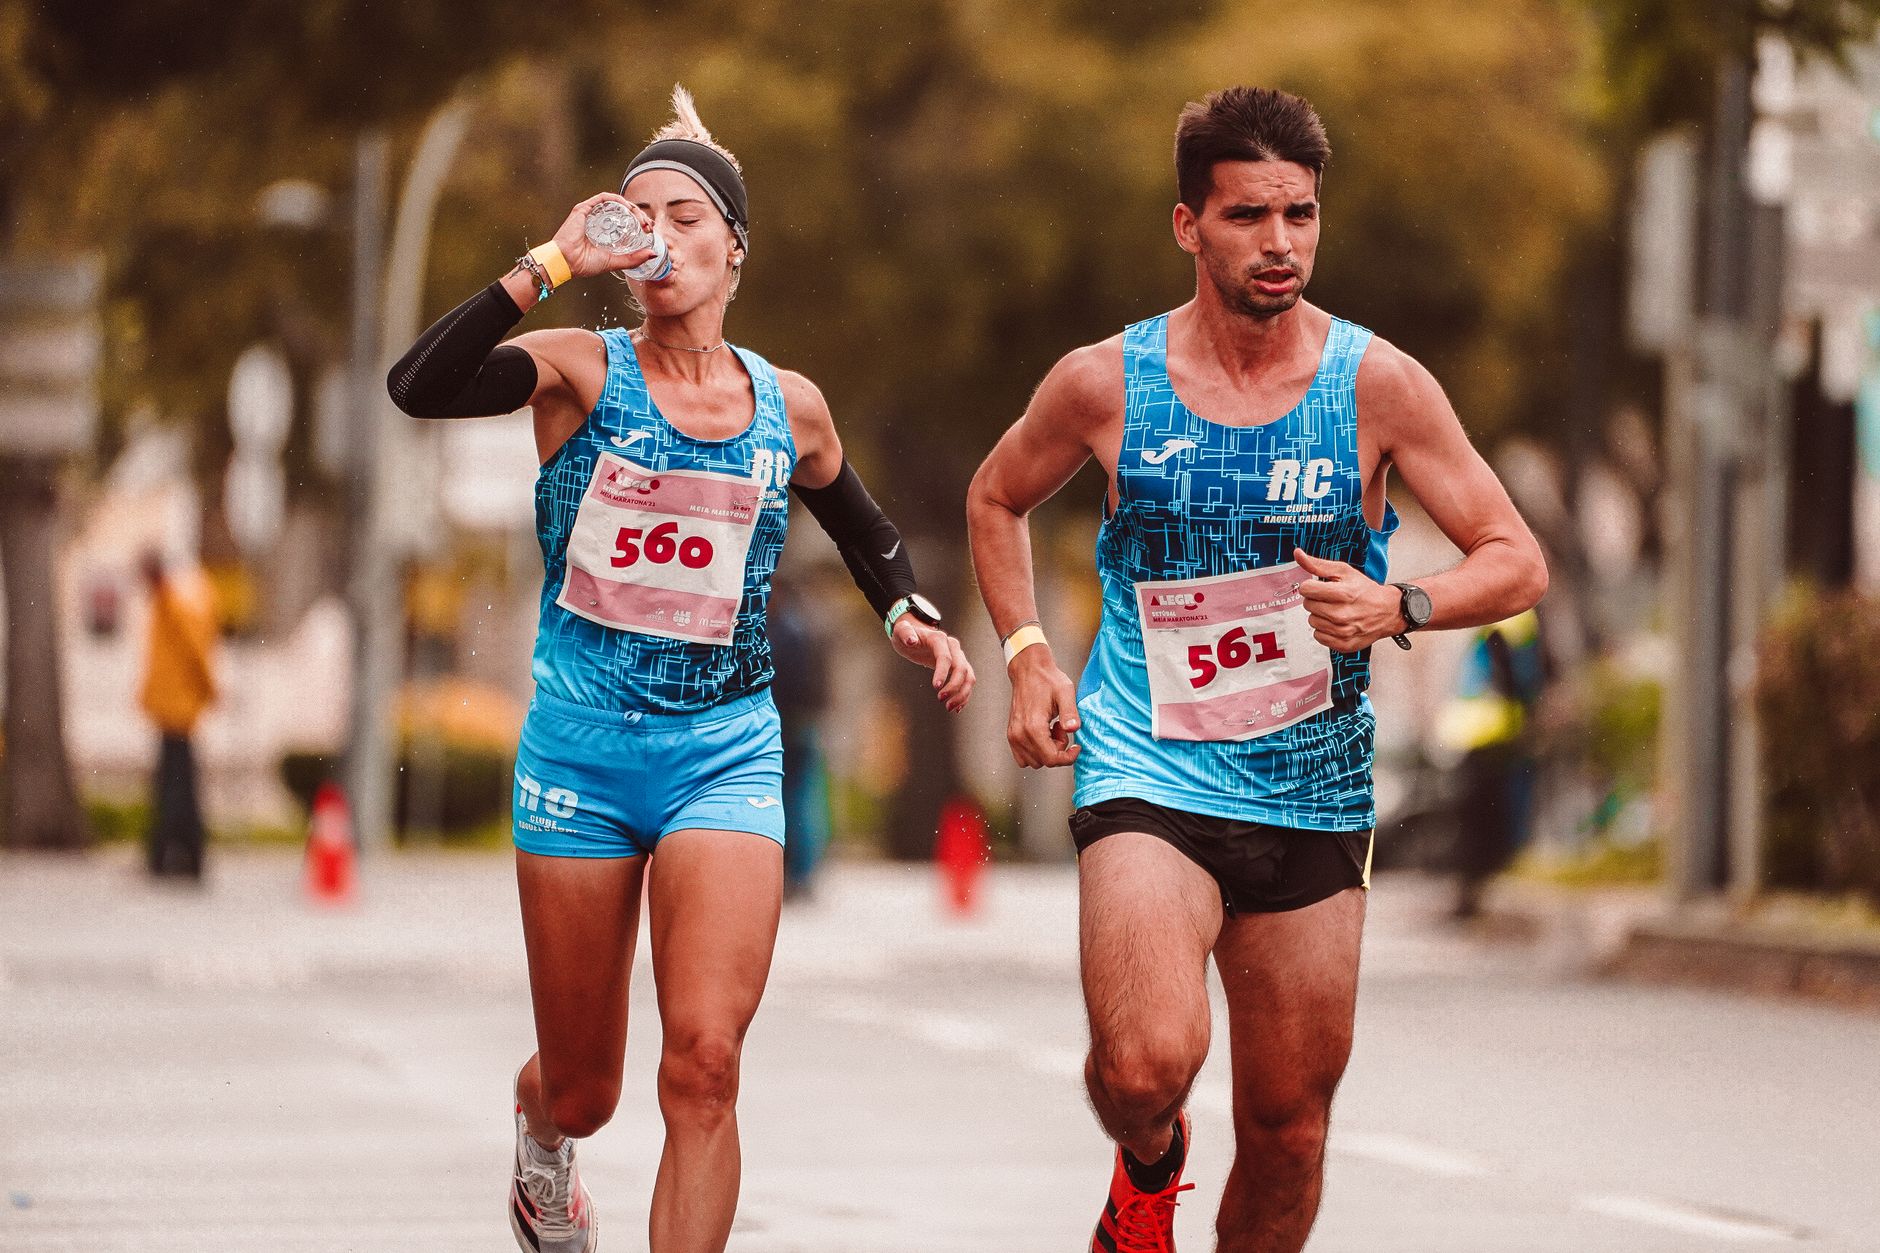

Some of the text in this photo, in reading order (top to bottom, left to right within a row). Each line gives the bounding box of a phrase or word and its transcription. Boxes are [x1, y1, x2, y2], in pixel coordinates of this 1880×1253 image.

[1265, 457, 1334, 501] RC
[1285, 503, 1314, 513] CLUBE
[1263, 515, 1297, 524] RAQUEL
[610, 521, 714, 569] 560
[1151, 592, 1205, 610] ALEGRO
[1245, 593, 1302, 612] MEIA MARATO
[1188, 626, 1286, 690] 561
